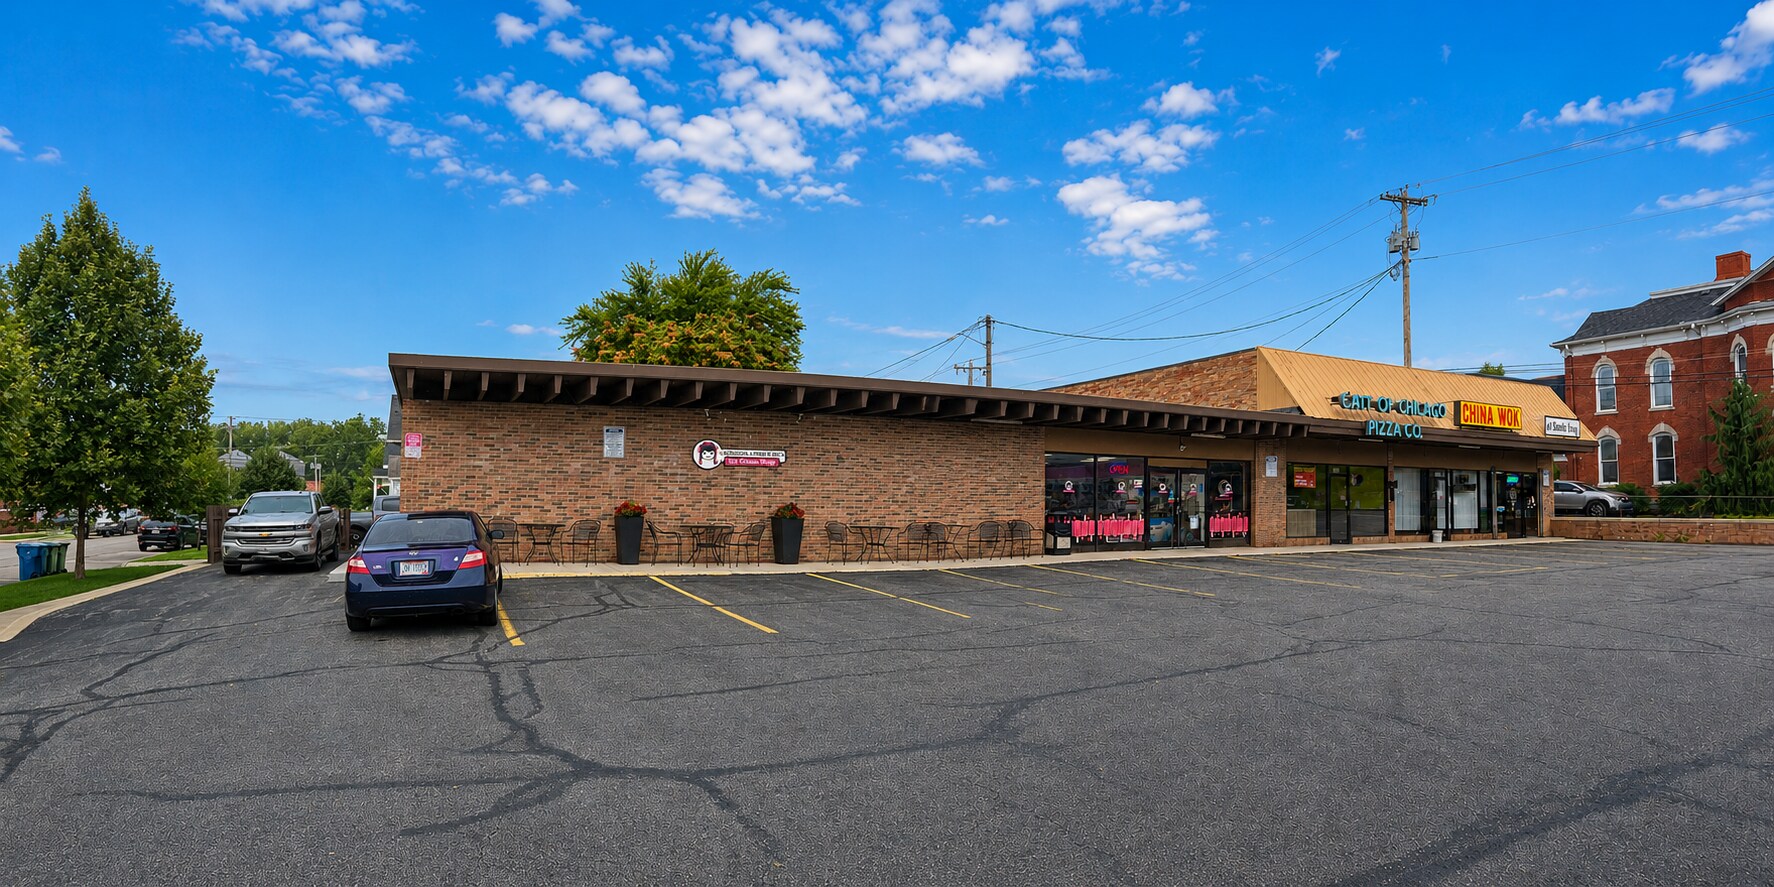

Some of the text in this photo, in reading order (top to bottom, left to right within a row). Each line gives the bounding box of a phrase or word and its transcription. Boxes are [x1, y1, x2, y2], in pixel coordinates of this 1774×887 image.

[1377, 396, 1393, 413] OF
[1462, 403, 1520, 427] CHINA WOK
[1366, 420, 1423, 438] PIZZA CO.
